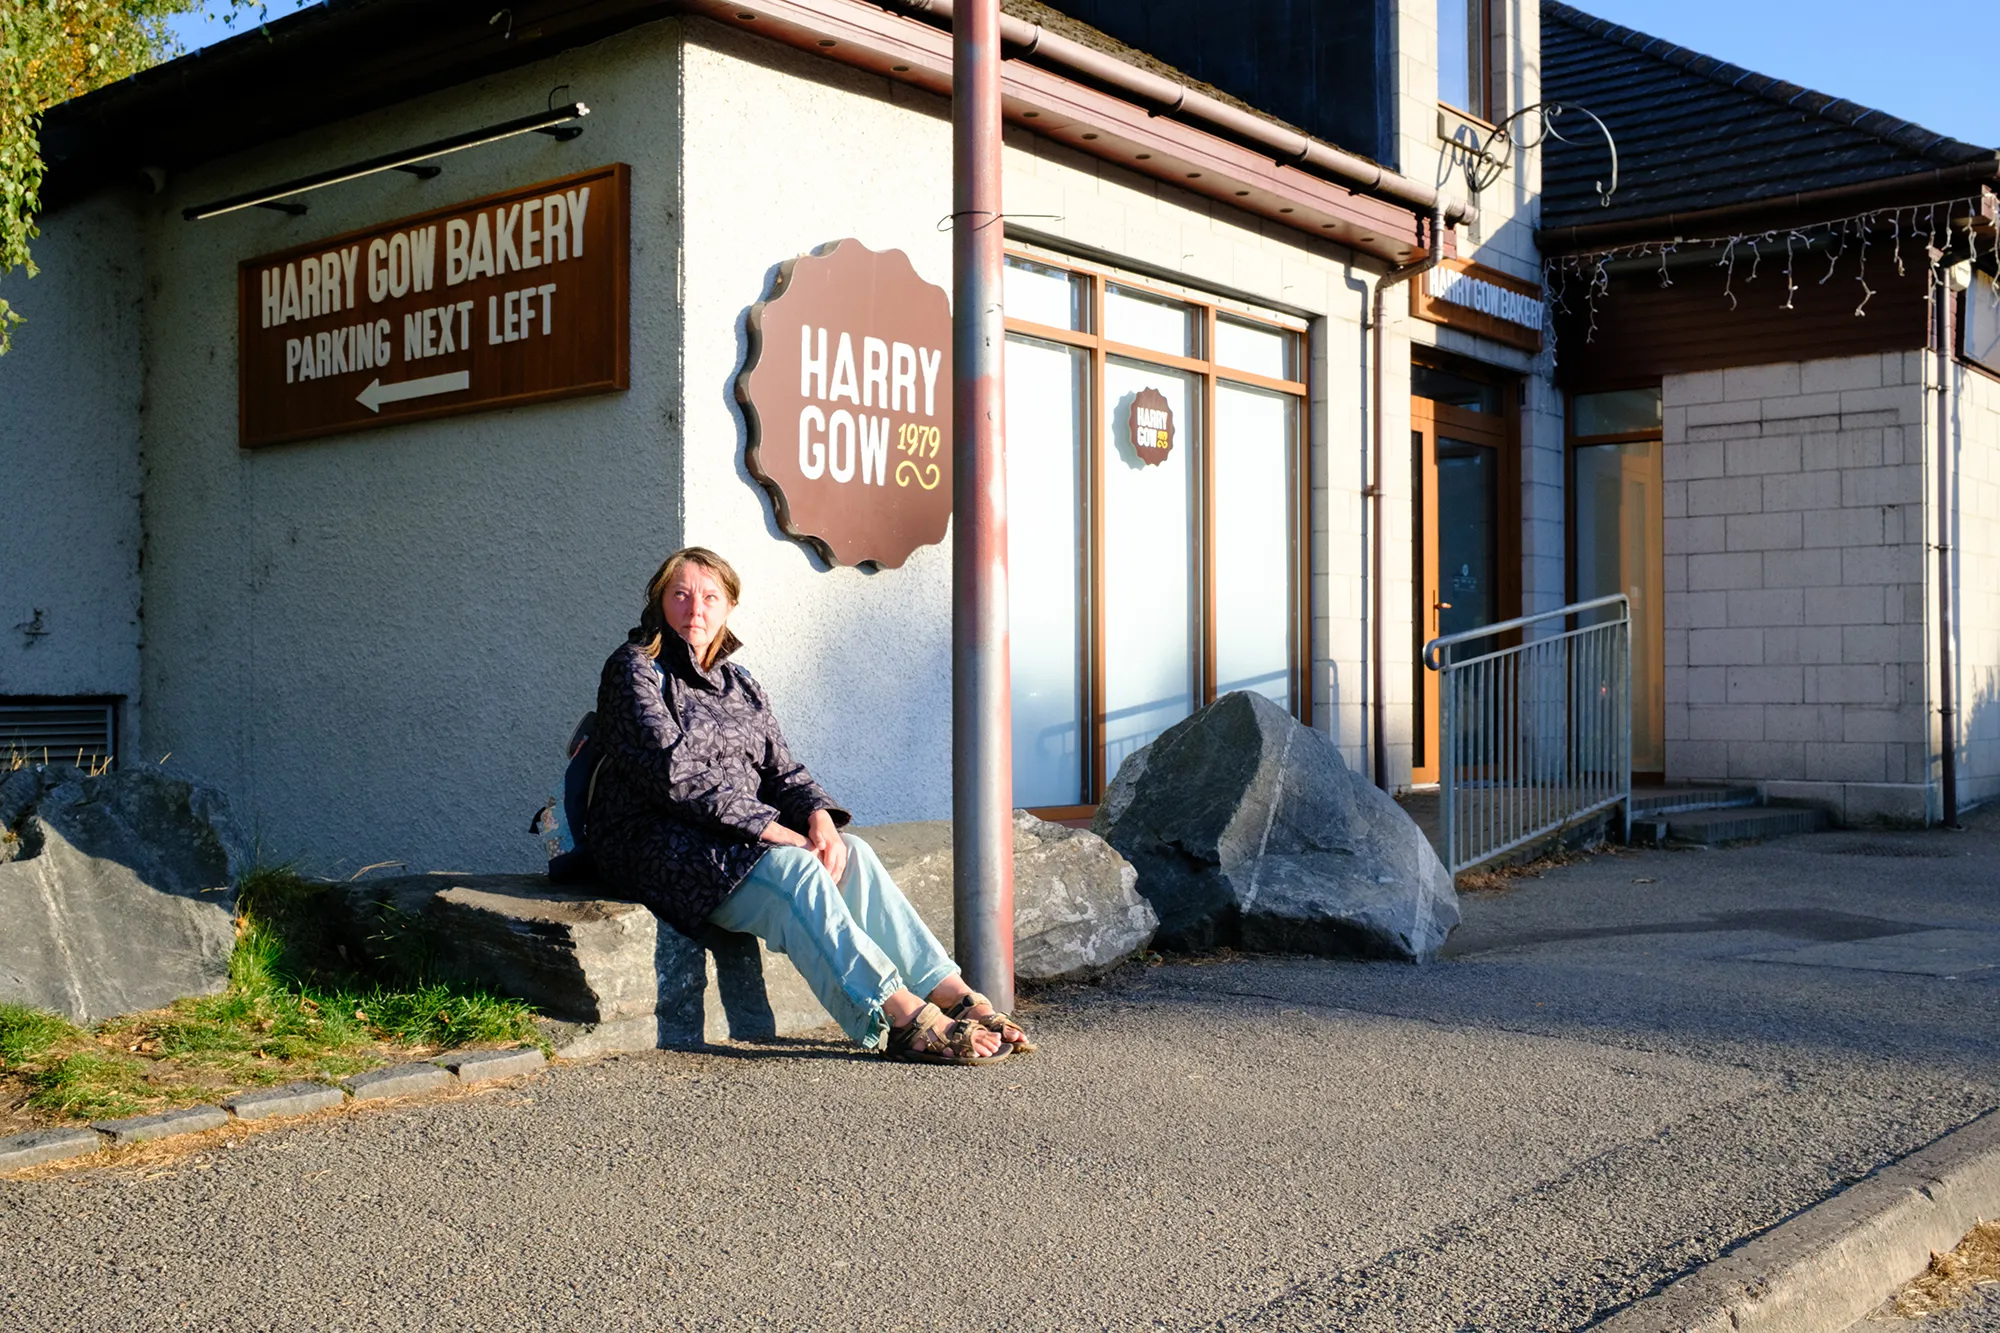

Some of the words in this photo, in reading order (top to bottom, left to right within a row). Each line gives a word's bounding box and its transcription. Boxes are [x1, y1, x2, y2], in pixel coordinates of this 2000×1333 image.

[261, 245, 359, 329] HARRY
[367, 225, 437, 304] GOW
[446, 187, 591, 287] BAKERY
[1429, 265, 1471, 307] HARRY
[1473, 278, 1499, 317] GOW
[1500, 287, 1545, 331] BAKERY
[286, 318, 391, 384] PARKING
[404, 300, 474, 361] NEXT
[488, 283, 557, 346] LEFT
[801, 324, 942, 417] HARRY
[798, 404, 890, 487] GOW
[897, 422, 941, 459] 1979
[1137, 406, 1168, 430] HARRY
[1137, 426, 1158, 448] GOW
